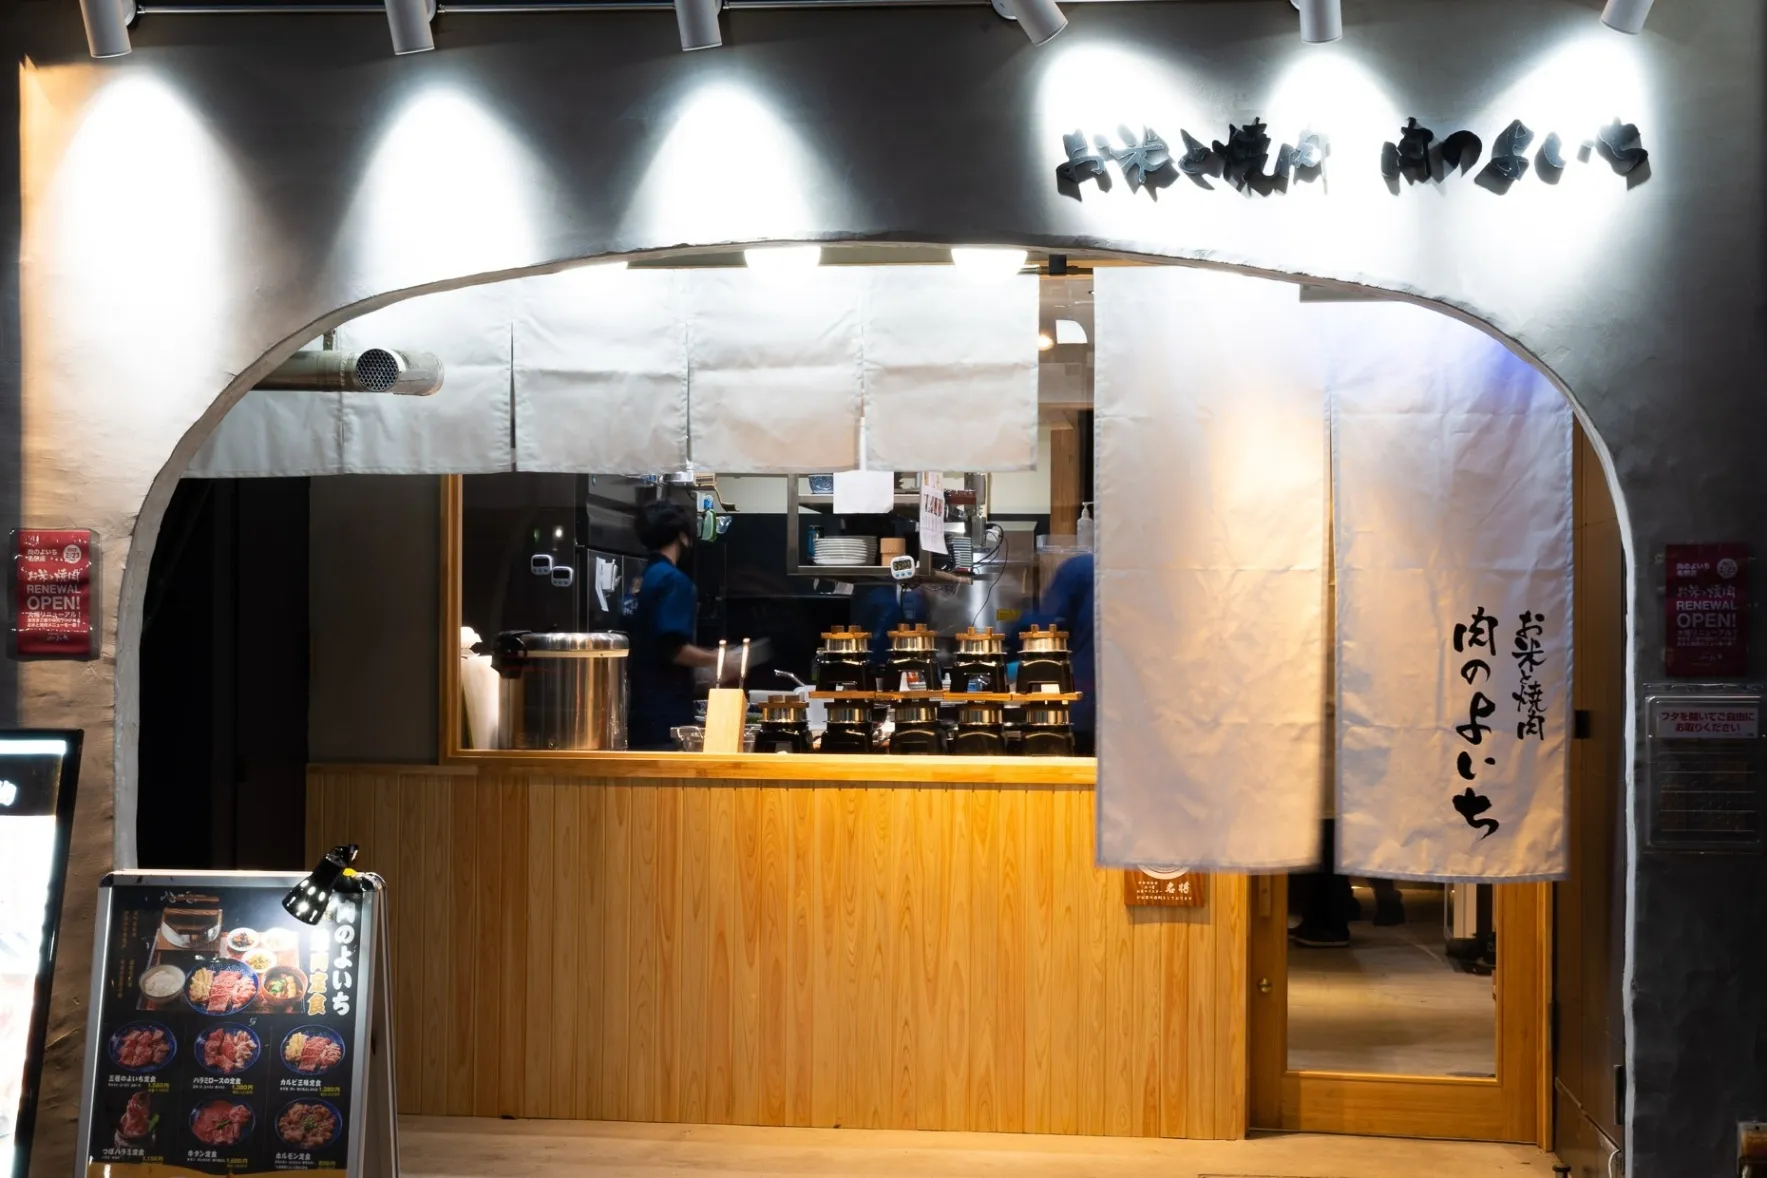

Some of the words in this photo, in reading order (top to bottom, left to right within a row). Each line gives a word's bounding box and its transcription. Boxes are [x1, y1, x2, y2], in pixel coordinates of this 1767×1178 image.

[1381, 117, 1650, 196] 肉のよいち
[27, 585, 81, 594] RENEWAL
[27, 596, 81, 610] OPEN!
[1676, 601, 1737, 611] RENEWAL
[1677, 613, 1736, 628] OPEN!
[1511, 610, 1548, 741] お米と焼肉
[1660, 711, 1755, 722] フタを開いてご自由に
[1452, 606, 1500, 842] 肉のよいち
[1675, 722, 1741, 733] お取りください
[187, 1149, 218, 1158] 牛タン定食
[275, 1151, 311, 1161] ホルモン定食
